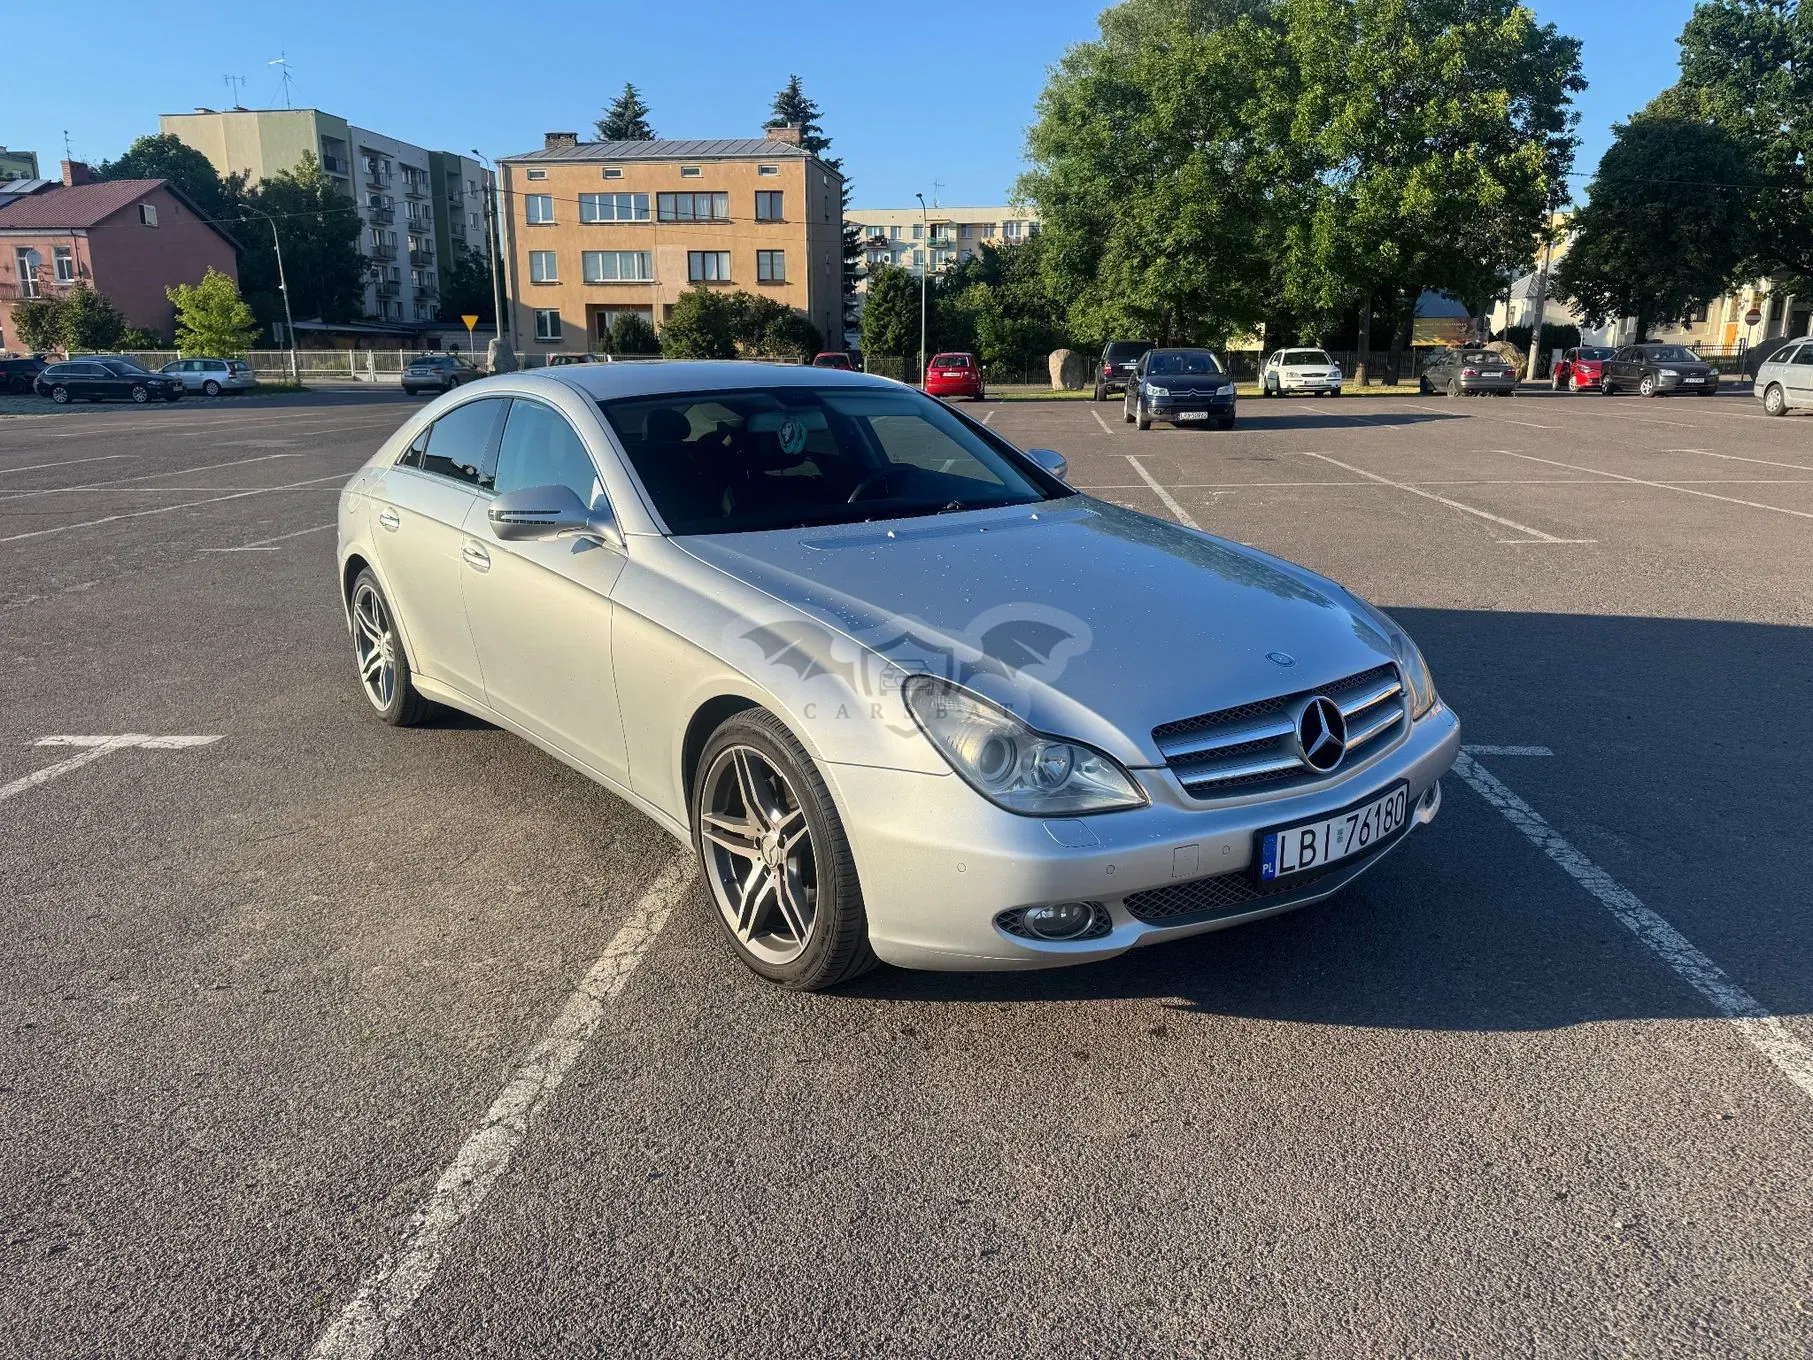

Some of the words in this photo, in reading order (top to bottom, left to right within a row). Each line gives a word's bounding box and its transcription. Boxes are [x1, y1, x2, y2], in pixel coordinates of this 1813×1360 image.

[1278, 823, 1331, 874] LBI
[1344, 790, 1405, 855] 76180
[1262, 863, 1274, 875] PL
